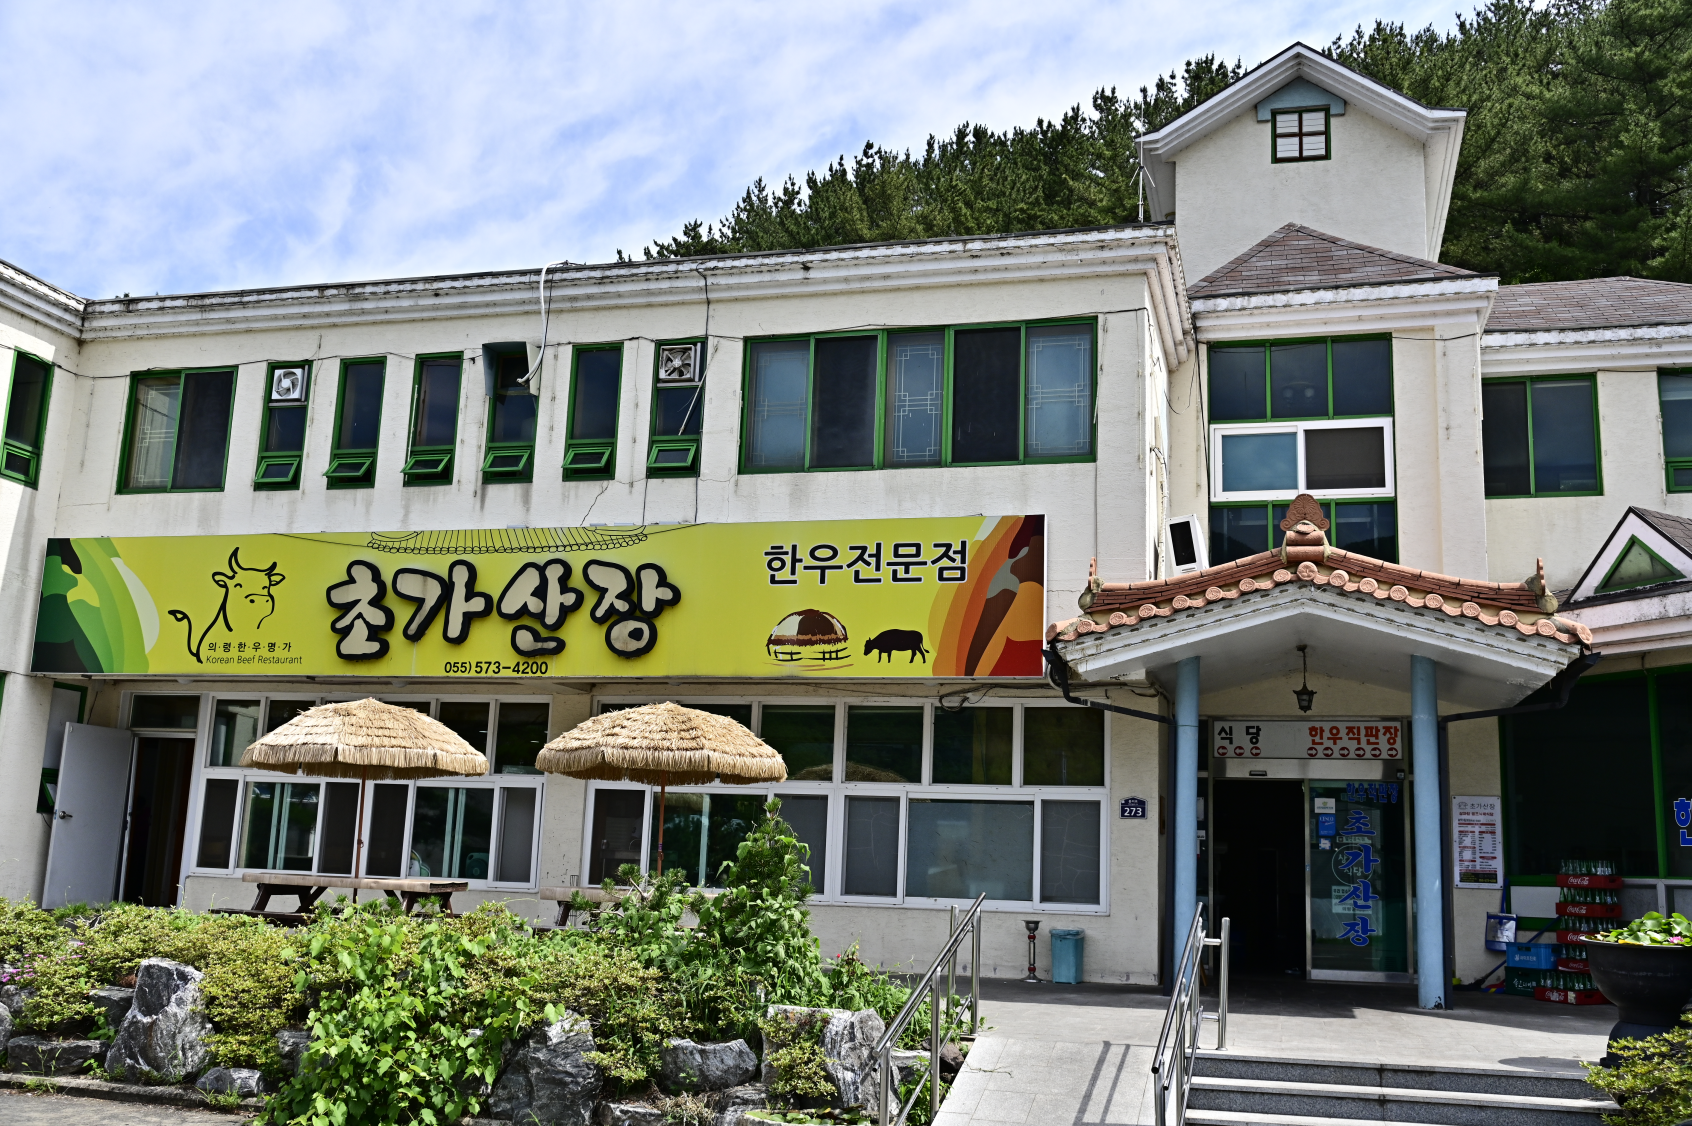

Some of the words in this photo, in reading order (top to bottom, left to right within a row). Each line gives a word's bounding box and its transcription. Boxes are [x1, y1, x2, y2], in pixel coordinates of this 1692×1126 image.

[764, 540, 969, 585] 한우전문점
[326, 559, 680, 660] 초가산장
[205, 655, 235, 664] Korean
[236, 655, 256, 664] Beef
[257, 655, 303, 664] Restaurant
[1308, 726, 1400, 745] 한우직판장
[1346, 782, 1398, 804] 한우직판장
[1124, 807, 1142, 816] 273
[1470, 802, 1496, 811] 초가산장
[1338, 810, 1380, 947] 초가산장
